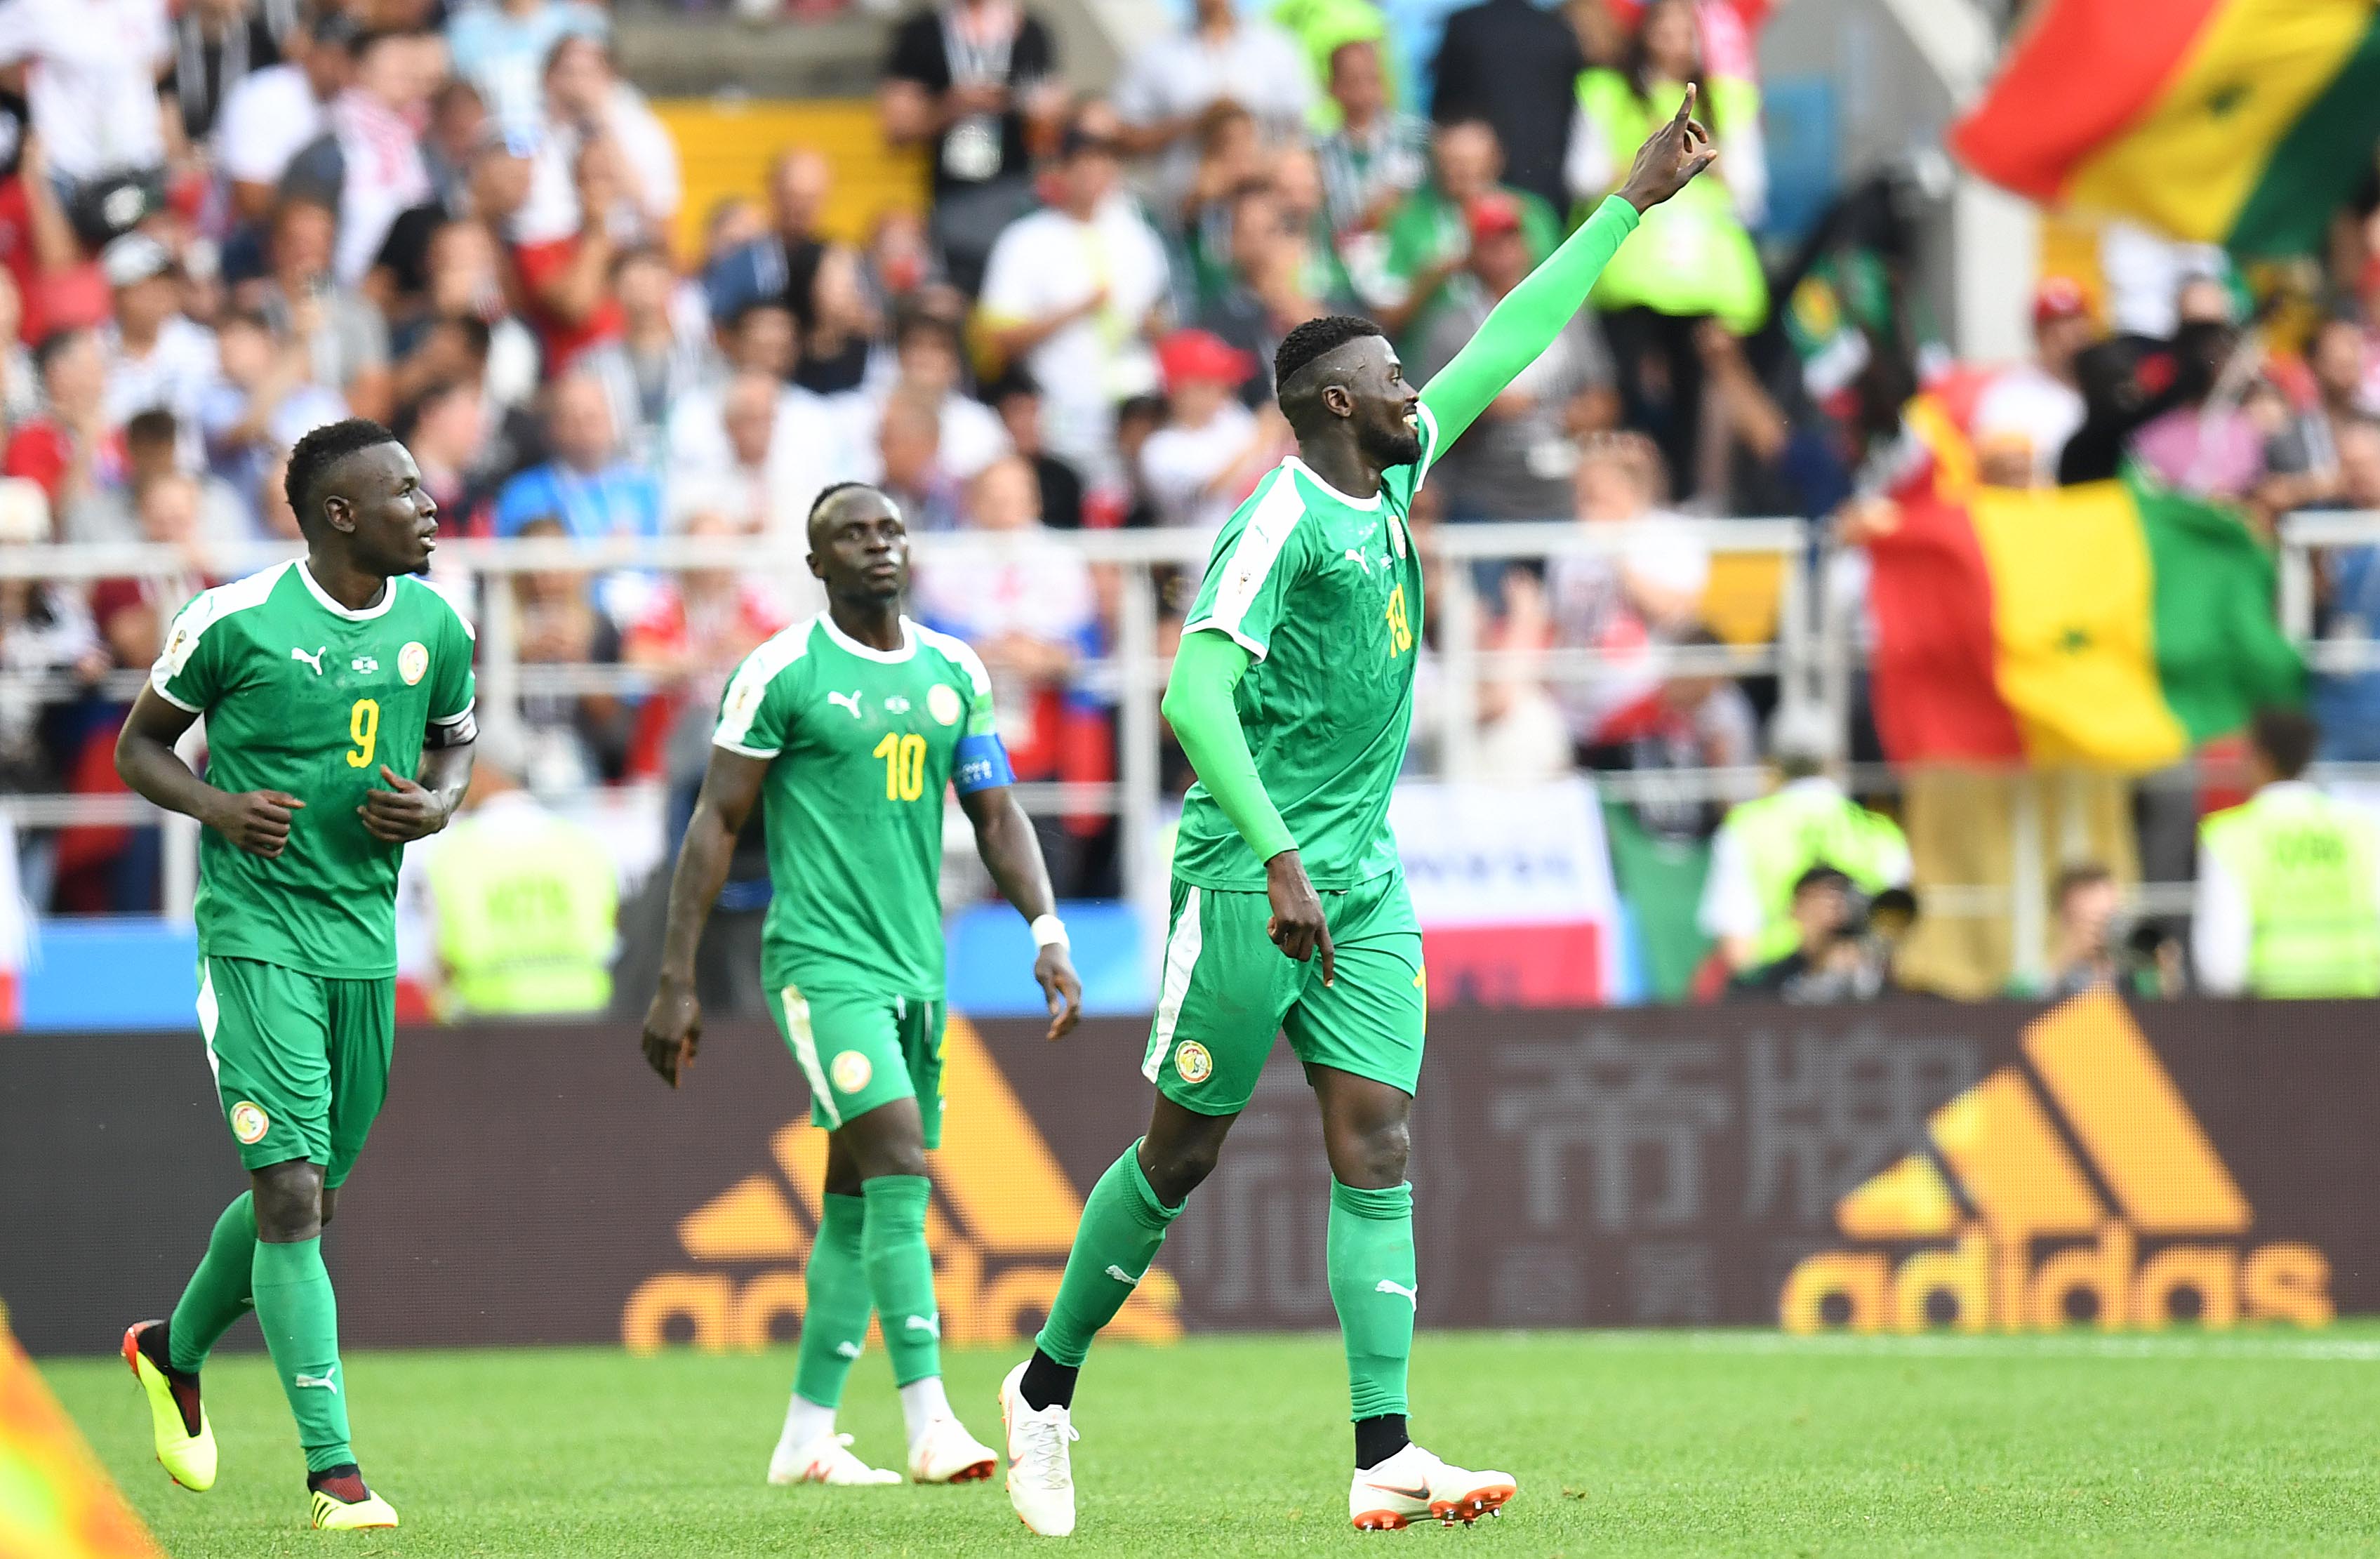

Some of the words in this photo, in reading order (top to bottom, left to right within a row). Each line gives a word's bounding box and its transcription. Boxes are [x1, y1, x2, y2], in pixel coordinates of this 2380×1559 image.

[1385, 582, 1412, 658] 19
[347, 698, 380, 769] 9
[872, 731, 926, 802] 10
[1779, 1218, 2336, 1332] adidas
